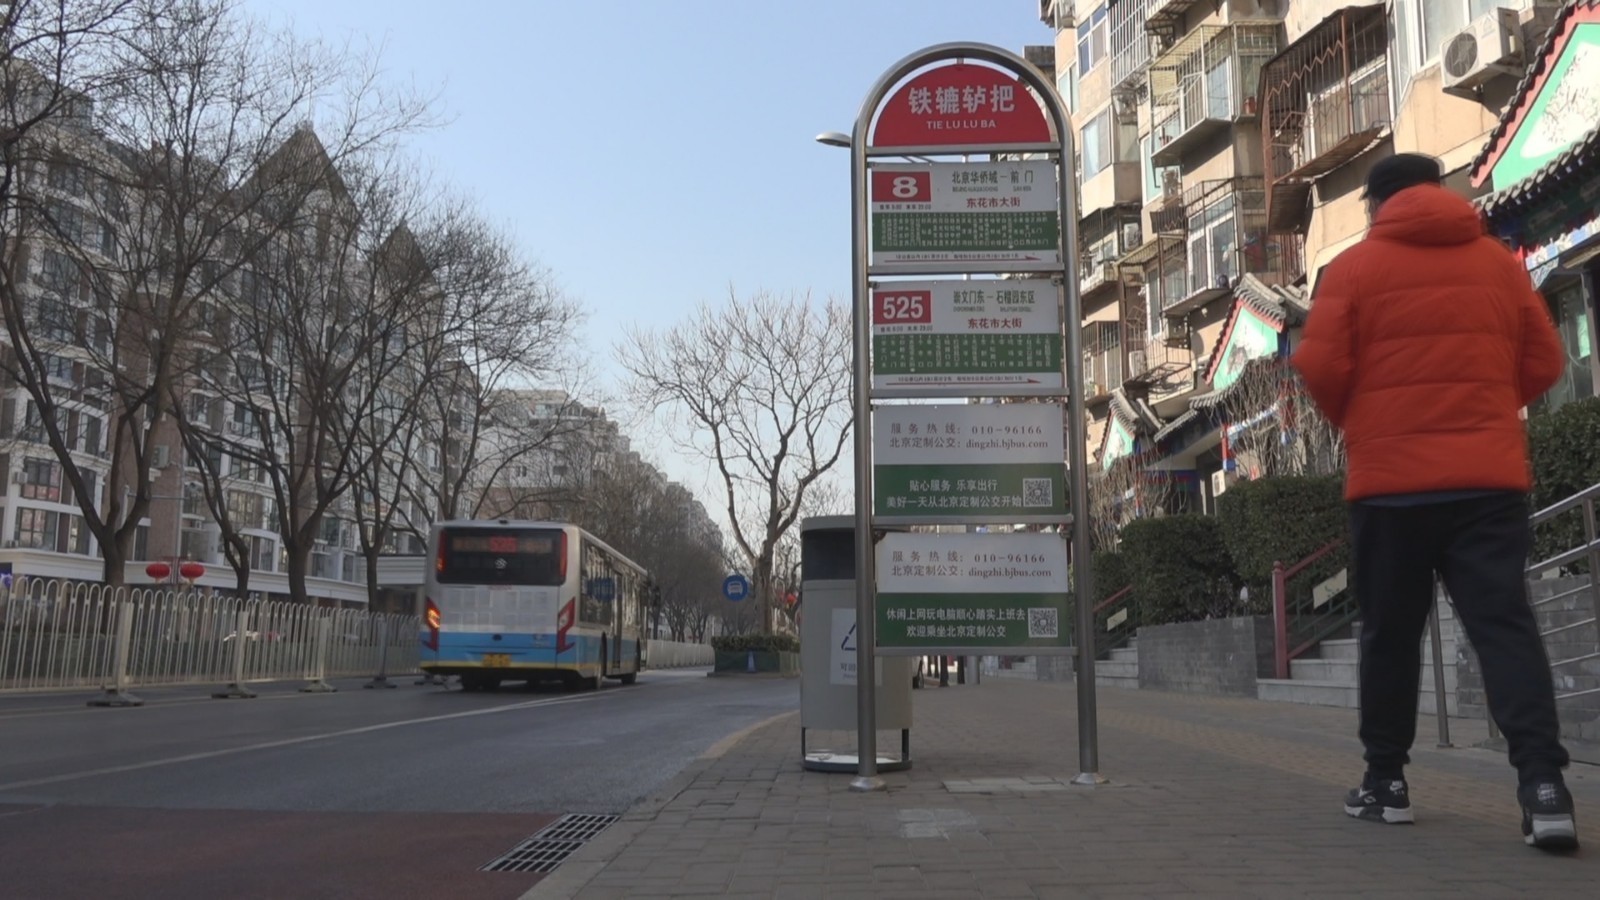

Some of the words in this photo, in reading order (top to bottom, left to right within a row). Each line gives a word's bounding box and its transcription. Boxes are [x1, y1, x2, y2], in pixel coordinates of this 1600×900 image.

[908, 84, 1015, 115] 铁辘轳把
[926, 120, 943, 130] TIE
[946, 120, 960, 129] LU
[963, 119, 978, 129] LU
[980, 119, 996, 128] BA
[892, 176, 918, 198] 8
[966, 196, 1021, 209] 东花市大街
[883, 295, 923, 320] 525
[967, 317, 1022, 330] 东花市大街
[971, 424, 1042, 435] 010-96166
[965, 439, 1048, 451] dingzhi.bjbus.com
[909, 479, 951, 492] 贴心服务
[956, 478, 998, 492] 乐享出行
[886, 495, 1022, 509] 美好一天从北京定制公交开始
[974, 553, 1046, 563] 010-96166
[968, 566, 1052, 579] dingzhi.bjbus.com
[906, 624, 1007, 638] 欢迎乘坐北京定制公交
